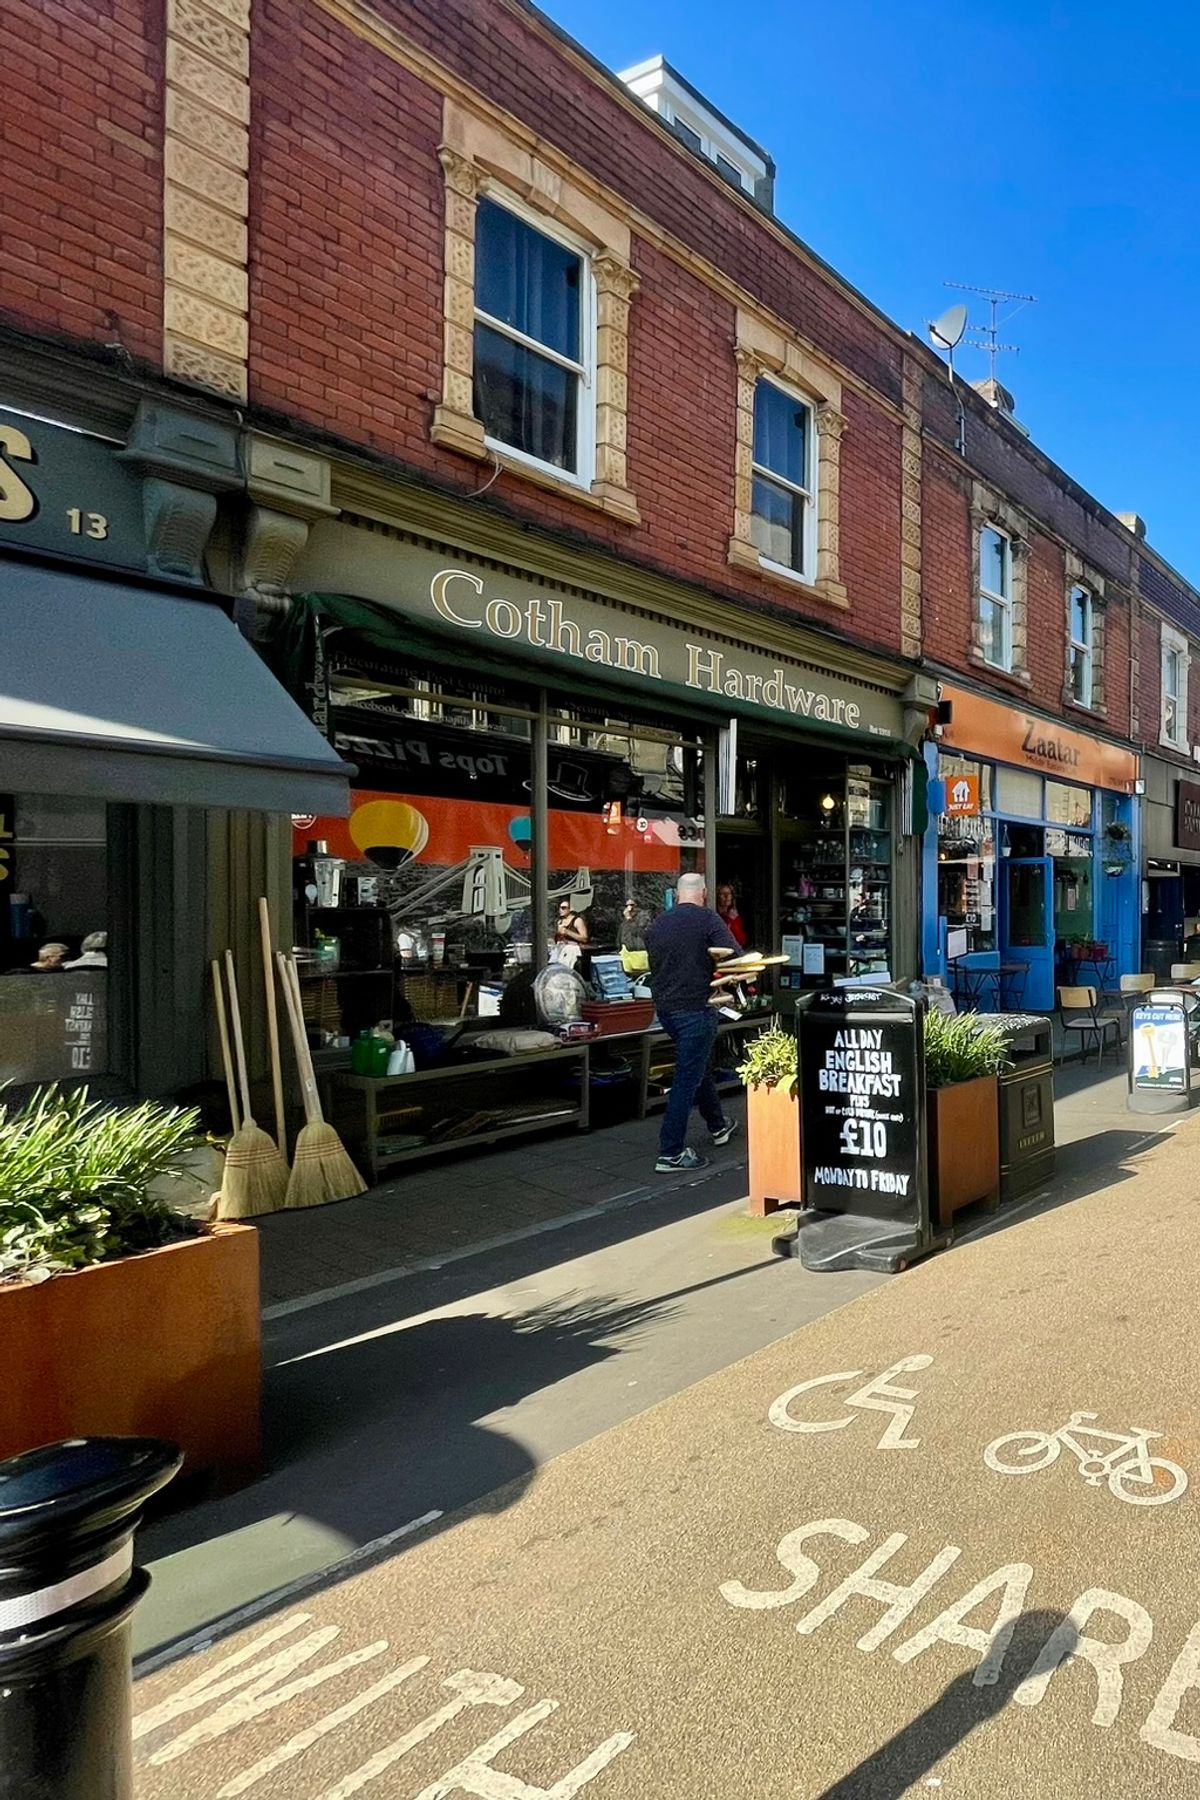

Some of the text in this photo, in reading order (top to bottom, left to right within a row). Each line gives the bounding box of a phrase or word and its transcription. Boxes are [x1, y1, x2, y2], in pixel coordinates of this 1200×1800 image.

[66, 507, 108, 540] 13
[430, 569, 861, 729] Cotham Hardware
[1020, 720, 1080, 767] Zaatar
[825, 1050, 892, 1075] ENGLISH
[819, 1068, 901, 1097] BREAKFAST
[840, 1119, 887, 1158] £10
[814, 1166, 910, 1196] MONDAY TO FRIDAY
